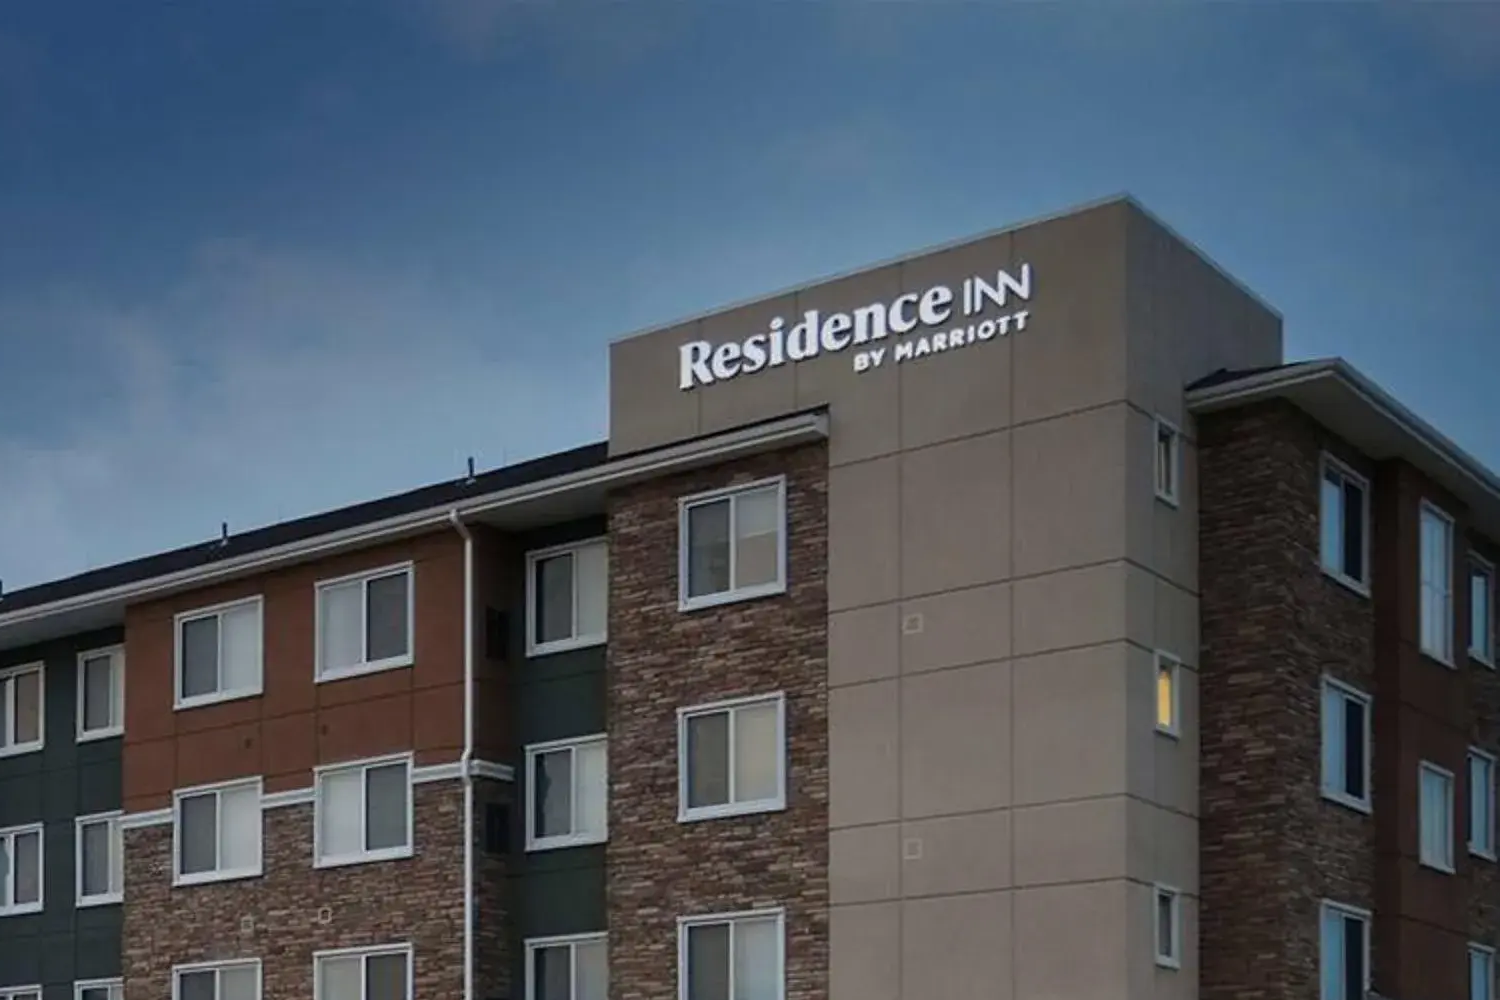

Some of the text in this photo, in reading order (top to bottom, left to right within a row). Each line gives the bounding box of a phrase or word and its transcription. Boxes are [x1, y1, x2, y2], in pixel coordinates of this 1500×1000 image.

[679, 263, 1031, 390] Residence INN
[853, 311, 1030, 373] BY MARRIOTT
